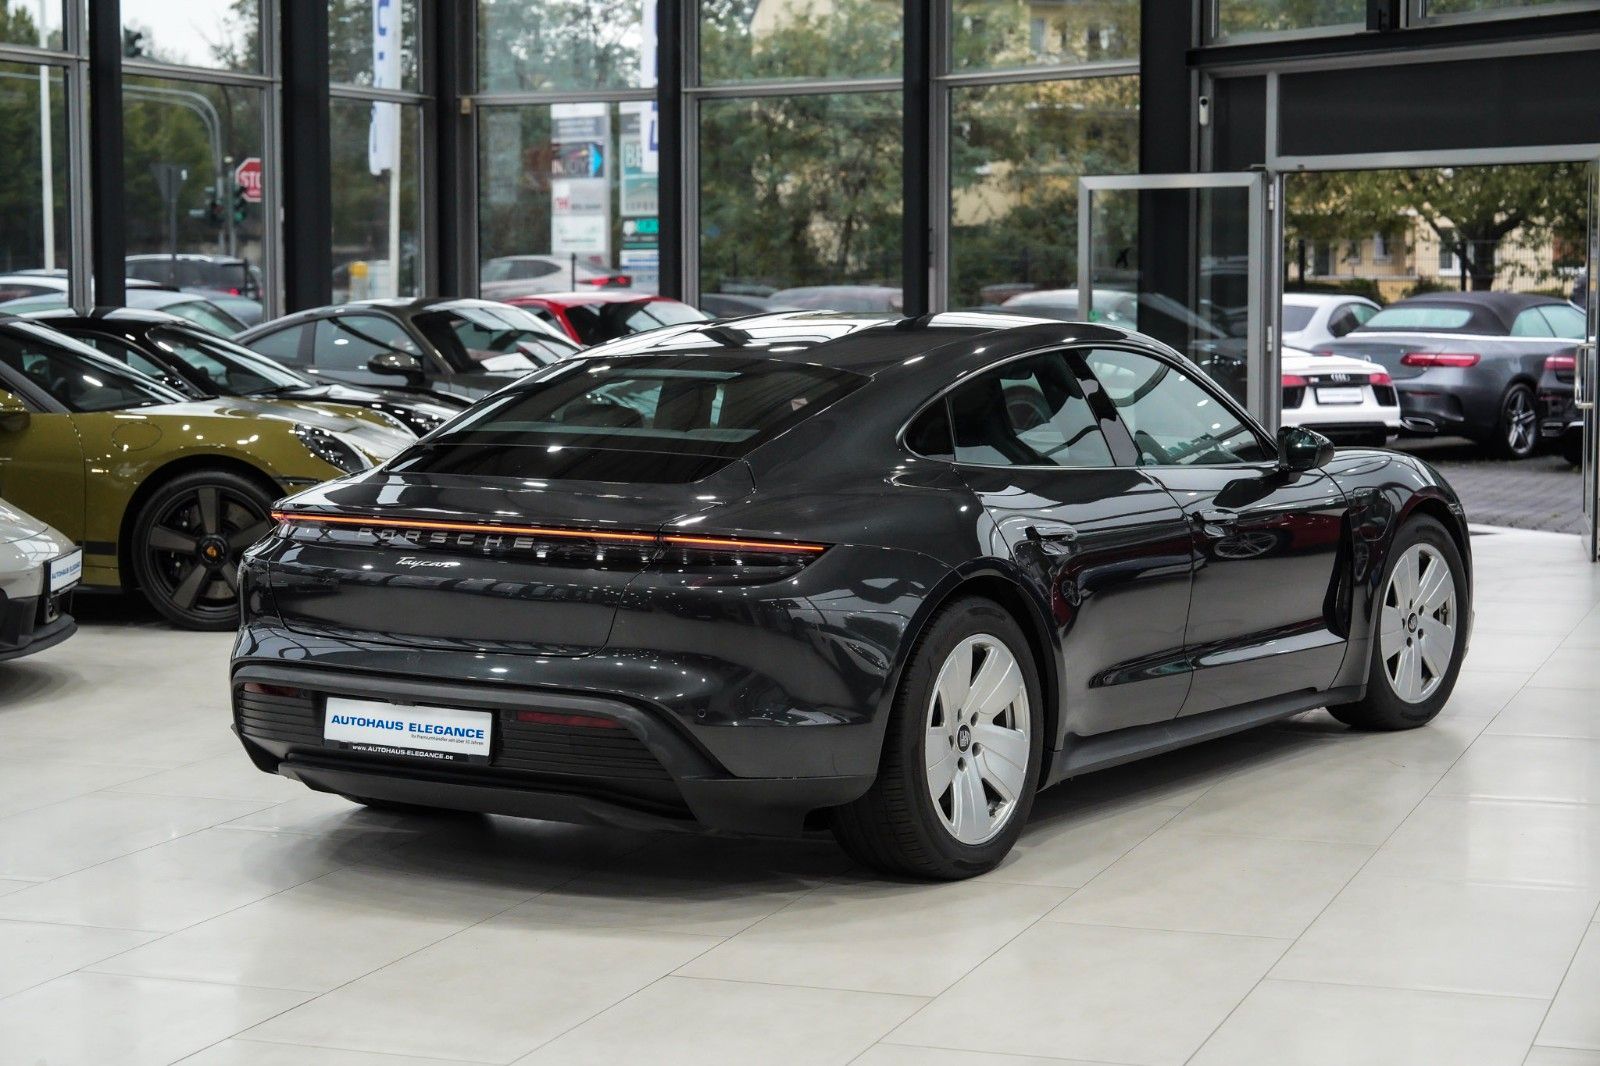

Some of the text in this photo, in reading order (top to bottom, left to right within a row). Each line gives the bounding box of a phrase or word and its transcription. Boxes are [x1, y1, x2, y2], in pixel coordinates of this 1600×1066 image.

[358, 527, 535, 549] PORSCHE
[395, 556, 461, 569] Taycan
[331, 714, 485, 739] AUTOHAUS ELEGANCE
